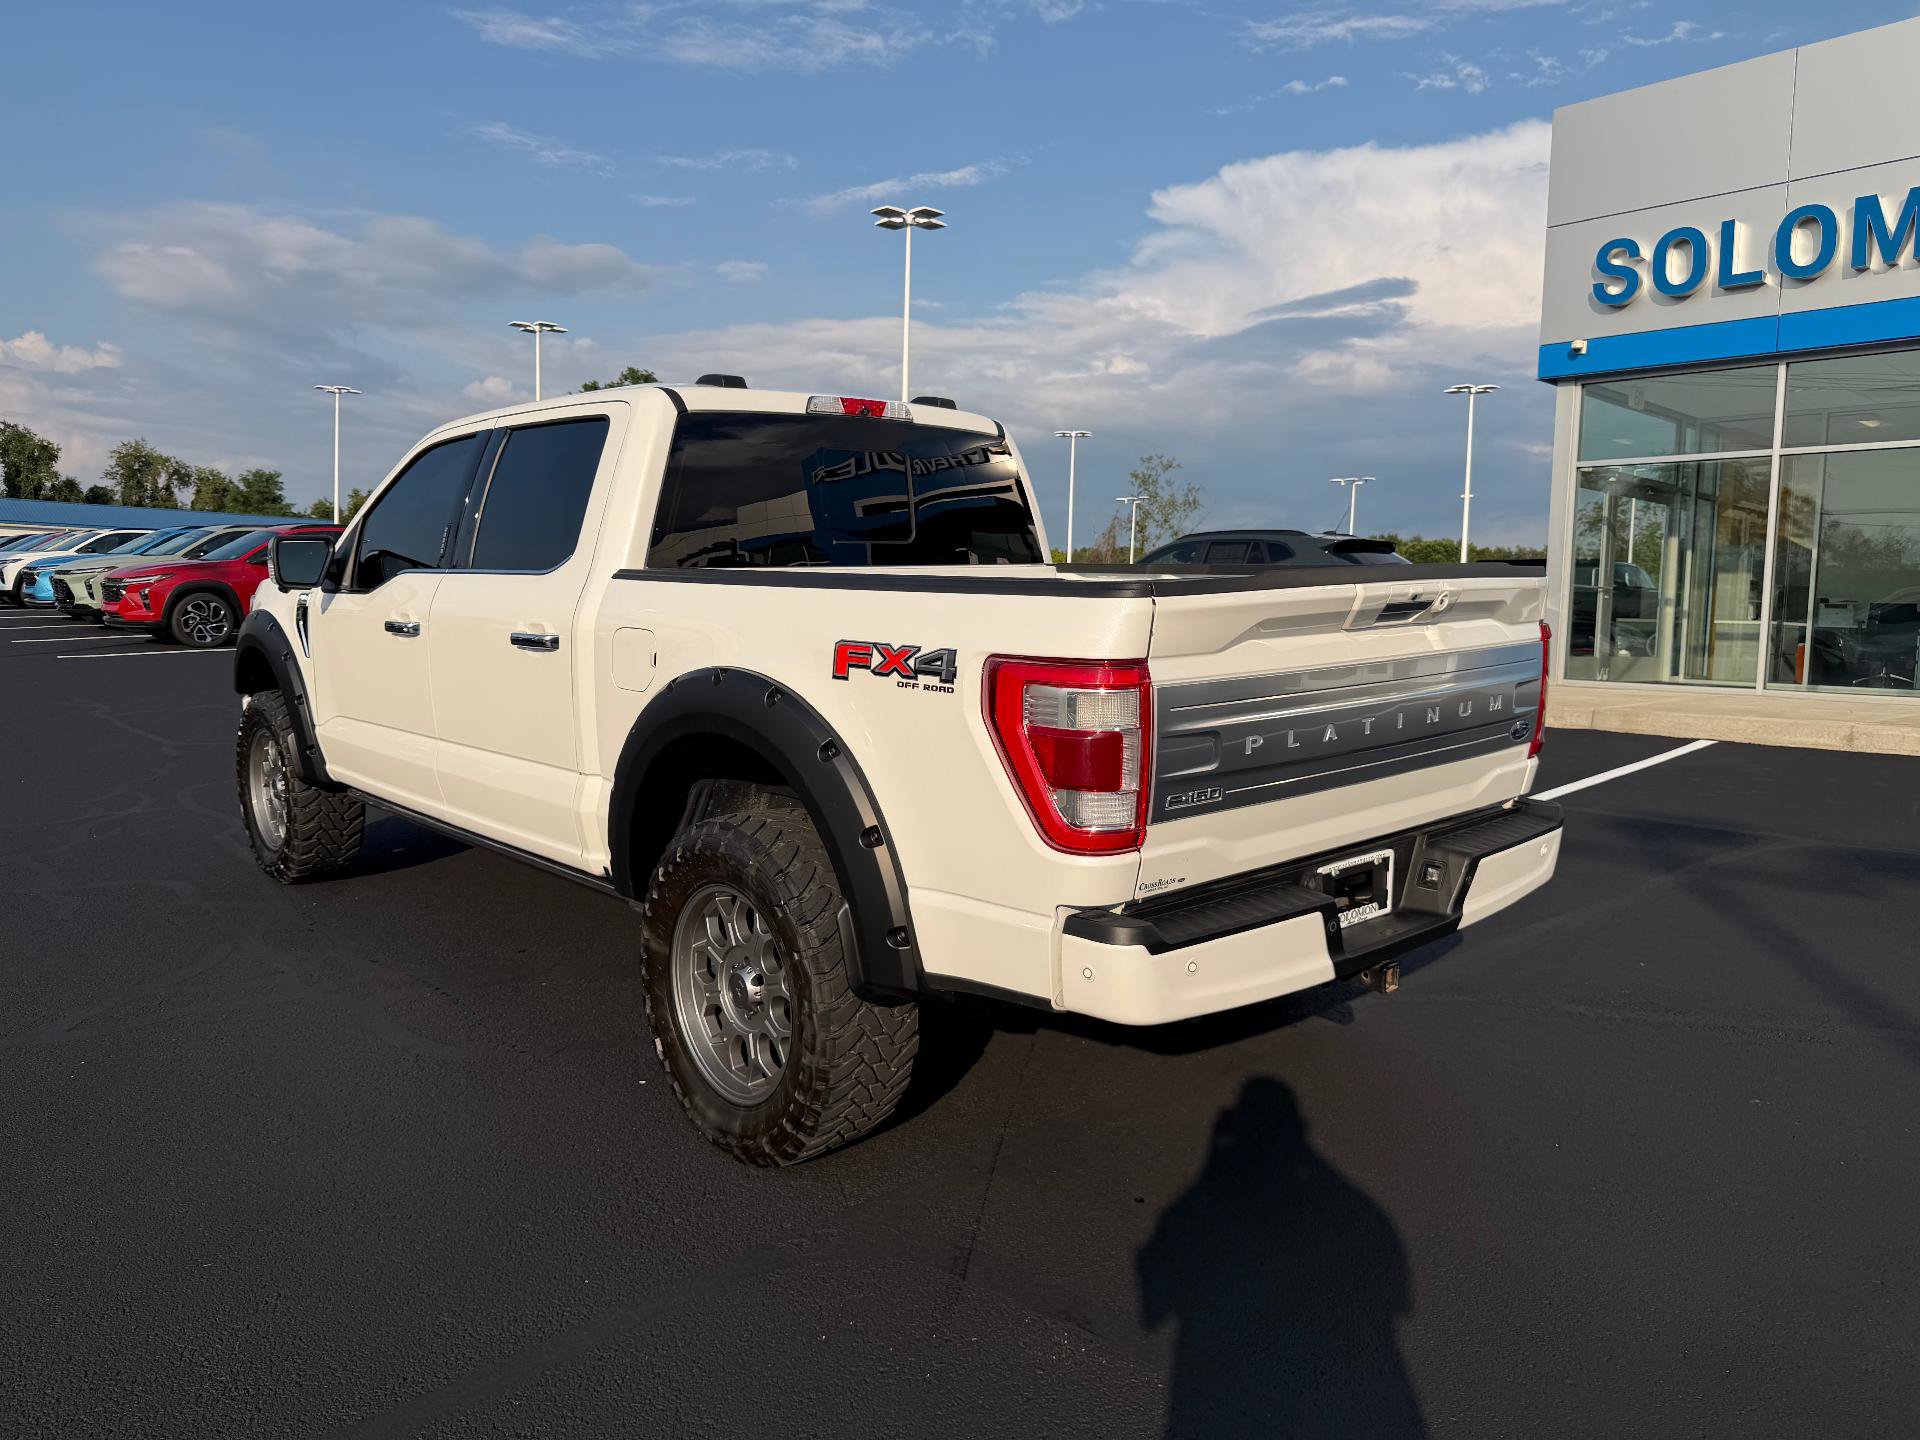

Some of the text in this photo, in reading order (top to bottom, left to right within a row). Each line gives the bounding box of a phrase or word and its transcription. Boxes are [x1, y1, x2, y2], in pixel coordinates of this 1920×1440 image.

[832, 639, 957, 685] FX4
[897, 681, 954, 694] OFF ROAD
[1245, 695, 1503, 755] PLATINUM
[1165, 787, 1223, 810] F-150
